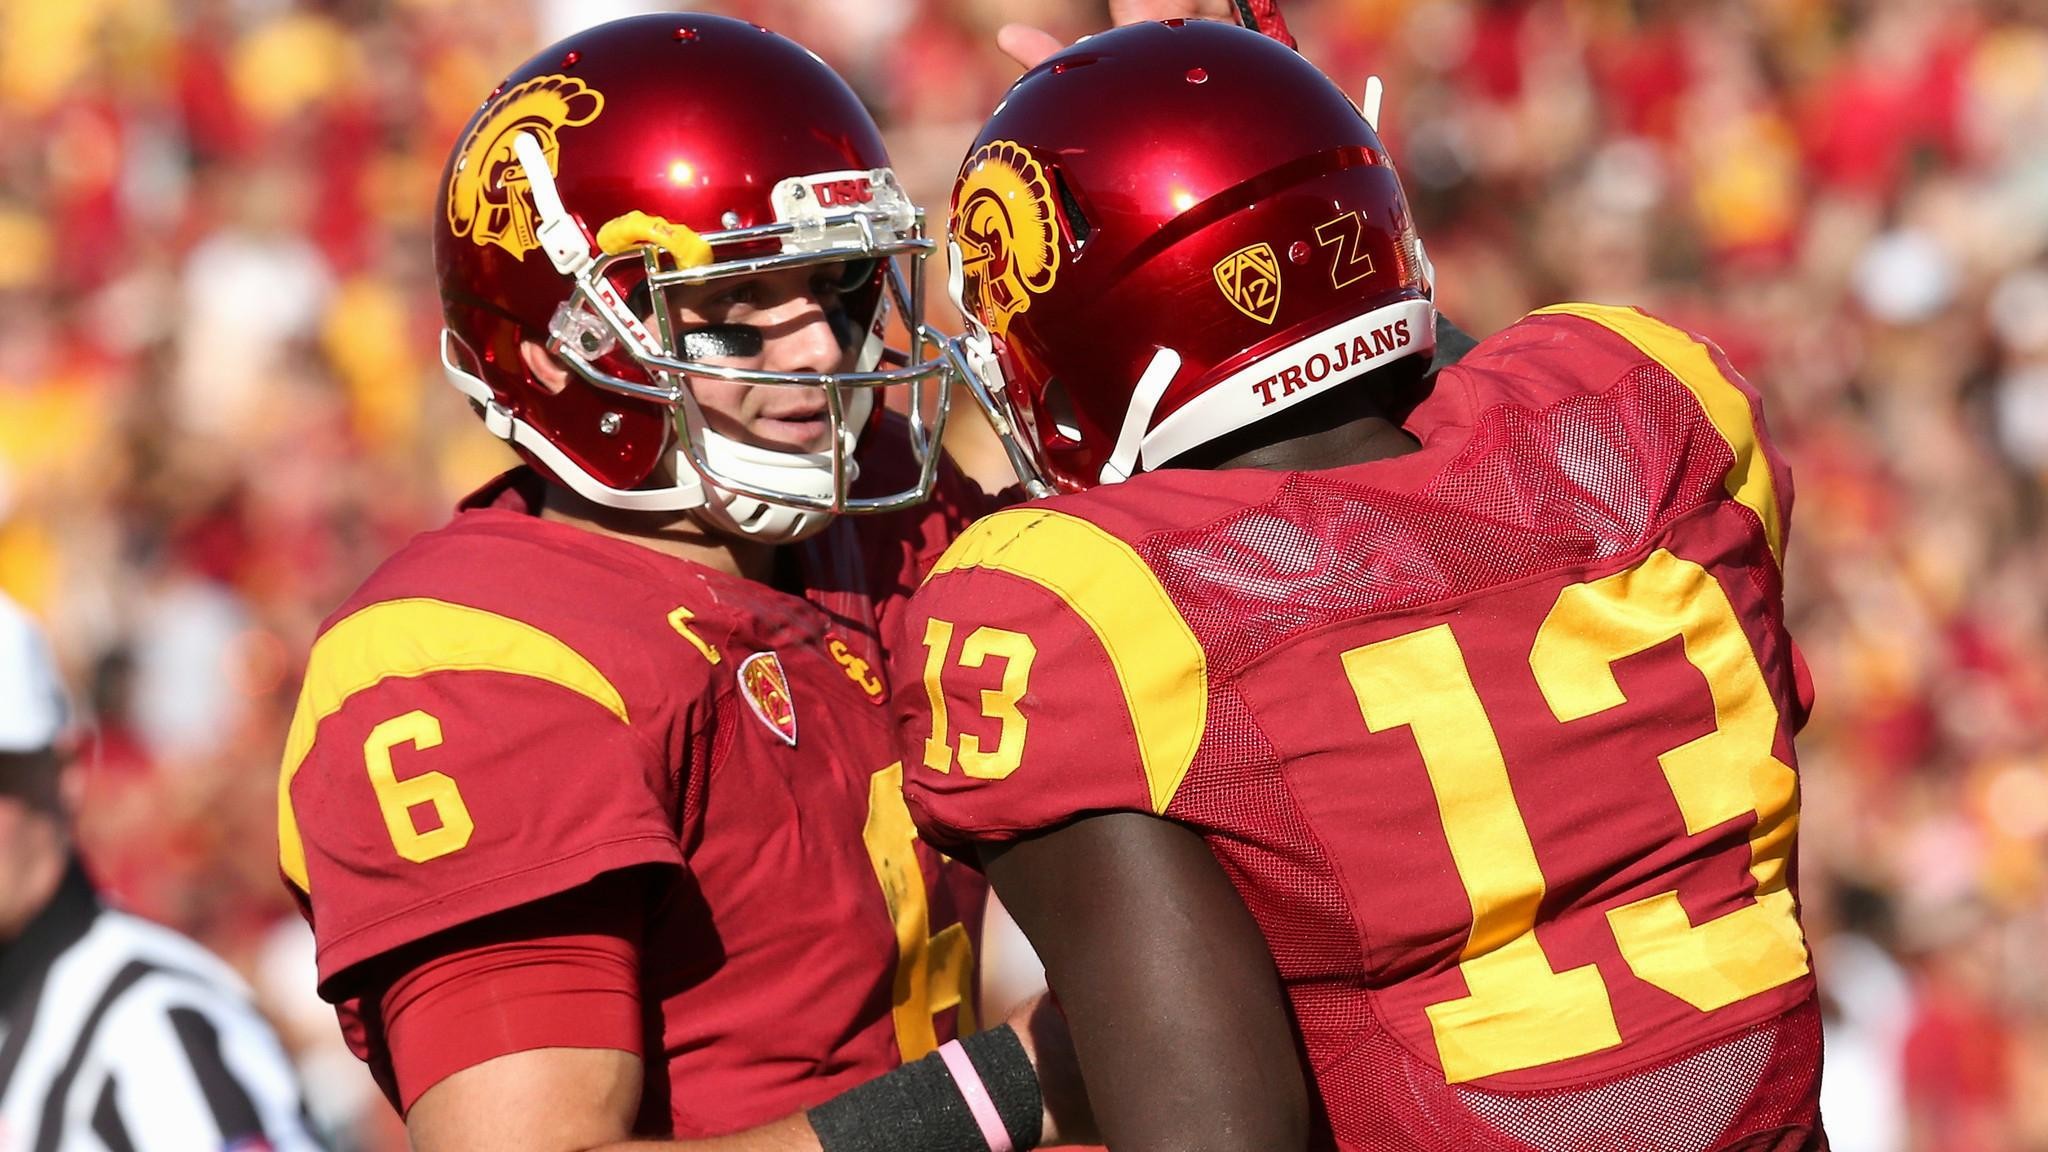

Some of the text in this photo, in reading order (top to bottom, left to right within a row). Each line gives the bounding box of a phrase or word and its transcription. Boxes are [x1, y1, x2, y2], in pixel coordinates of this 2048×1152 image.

[1215, 246, 1277, 302] PAC
[1240, 277, 1276, 313] 12
[1314, 210, 1377, 290] Z
[1252, 318, 1412, 408] TROJANS
[922, 617, 1037, 779] 13
[363, 709, 475, 864] 6
[1340, 547, 1811, 1085] 13
